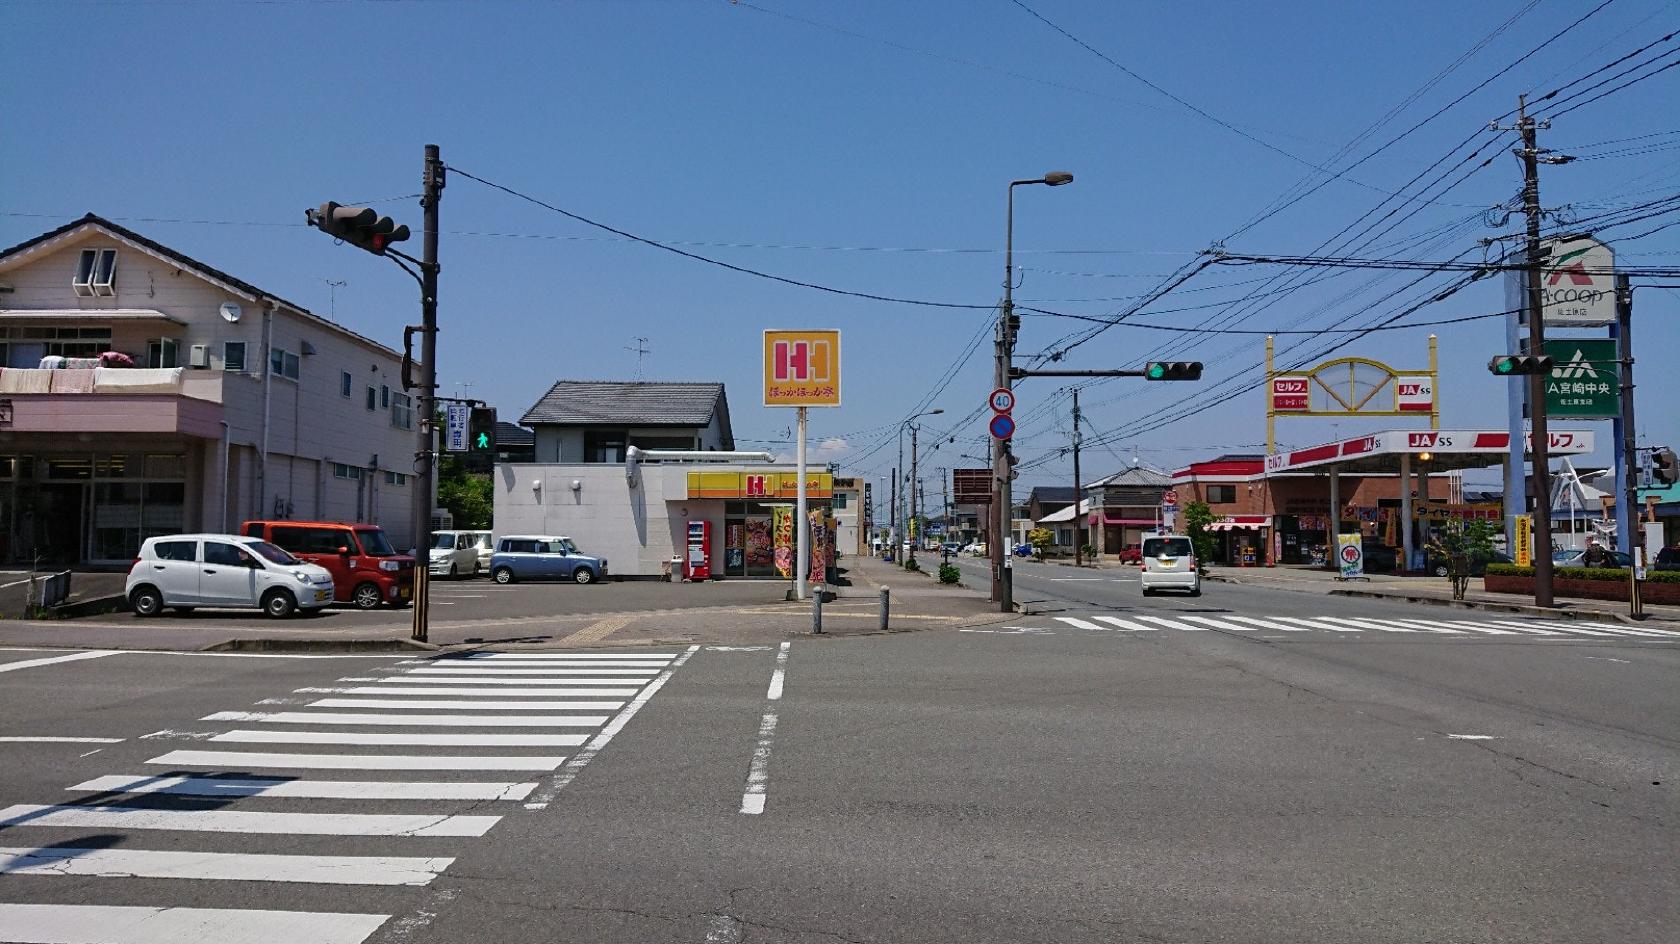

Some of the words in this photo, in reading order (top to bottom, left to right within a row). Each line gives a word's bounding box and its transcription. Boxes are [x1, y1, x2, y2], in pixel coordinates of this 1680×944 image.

[1276, 383, 1302, 391] セルフ
[1401, 385, 1417, 395] JA
[996, 395, 1010, 407] 40
[1411, 435, 1432, 447] JA
